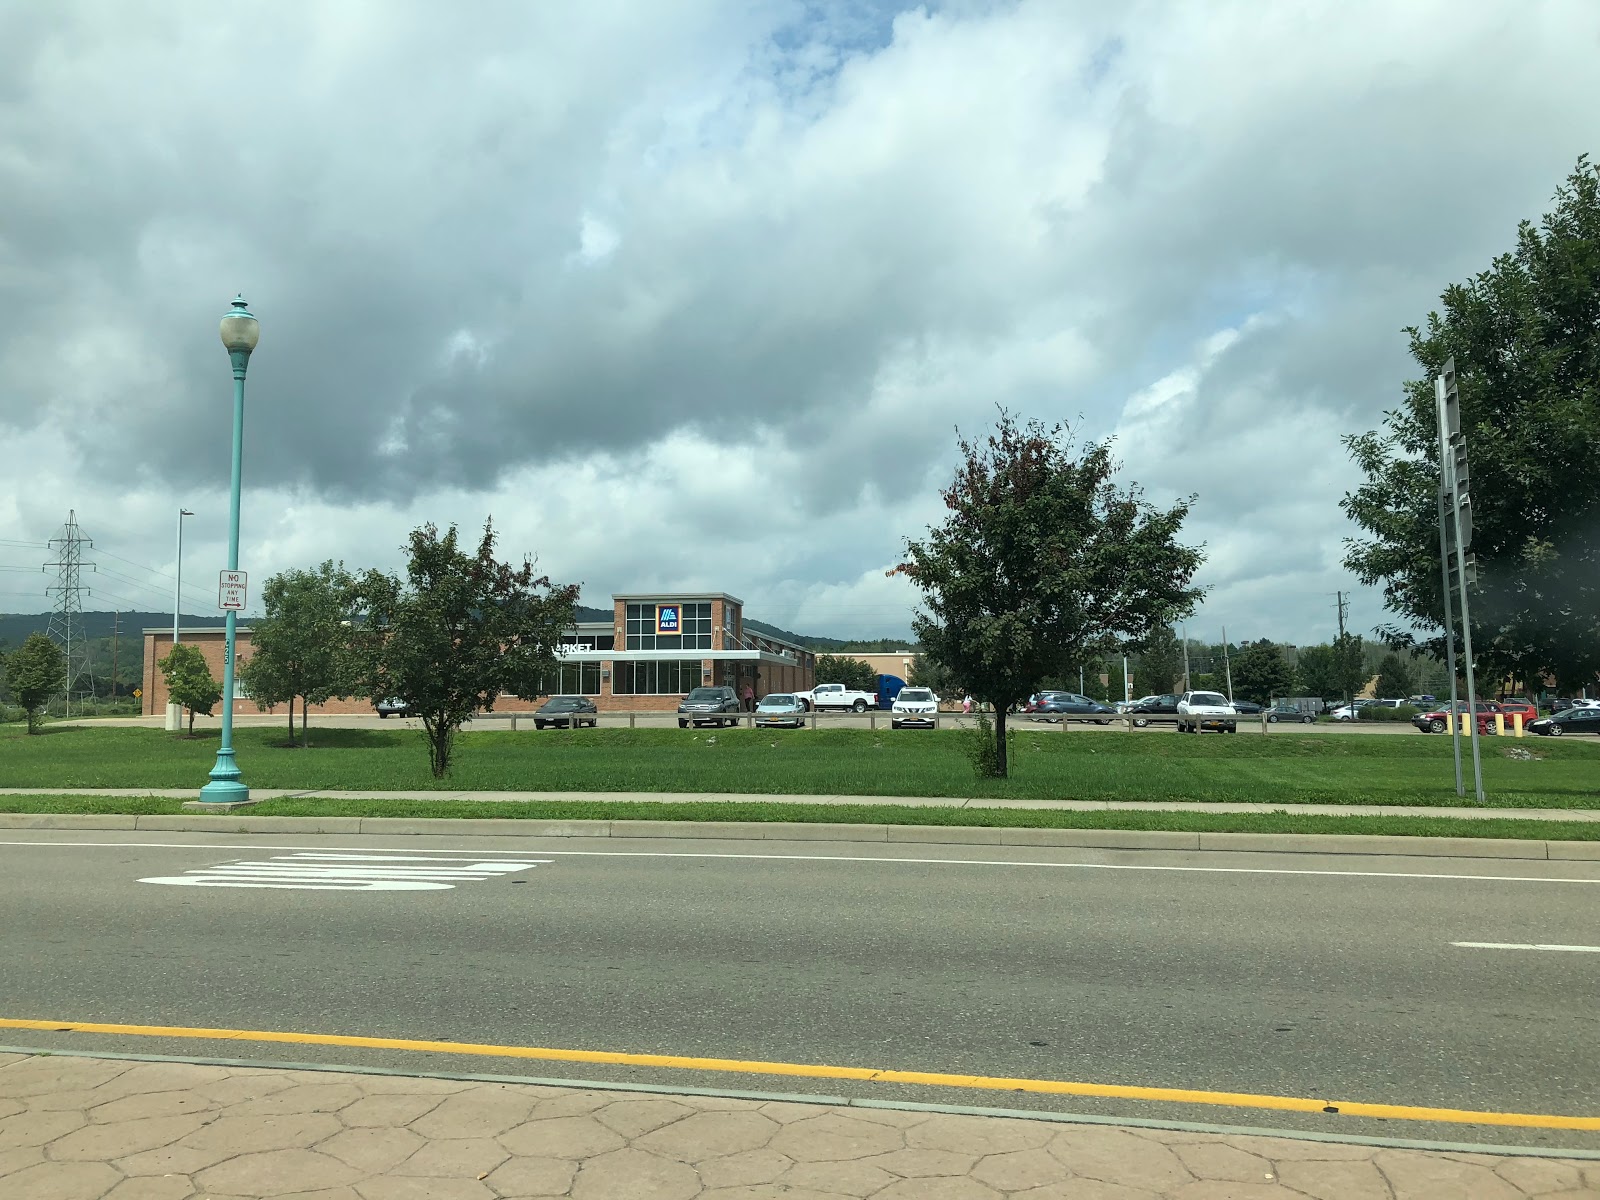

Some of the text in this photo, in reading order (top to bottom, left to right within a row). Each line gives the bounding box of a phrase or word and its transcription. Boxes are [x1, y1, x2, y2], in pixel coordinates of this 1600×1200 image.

[228, 574, 239, 582] NO
[549, 644, 592, 652] ARKET
[136, 853, 555, 890] ONLY
